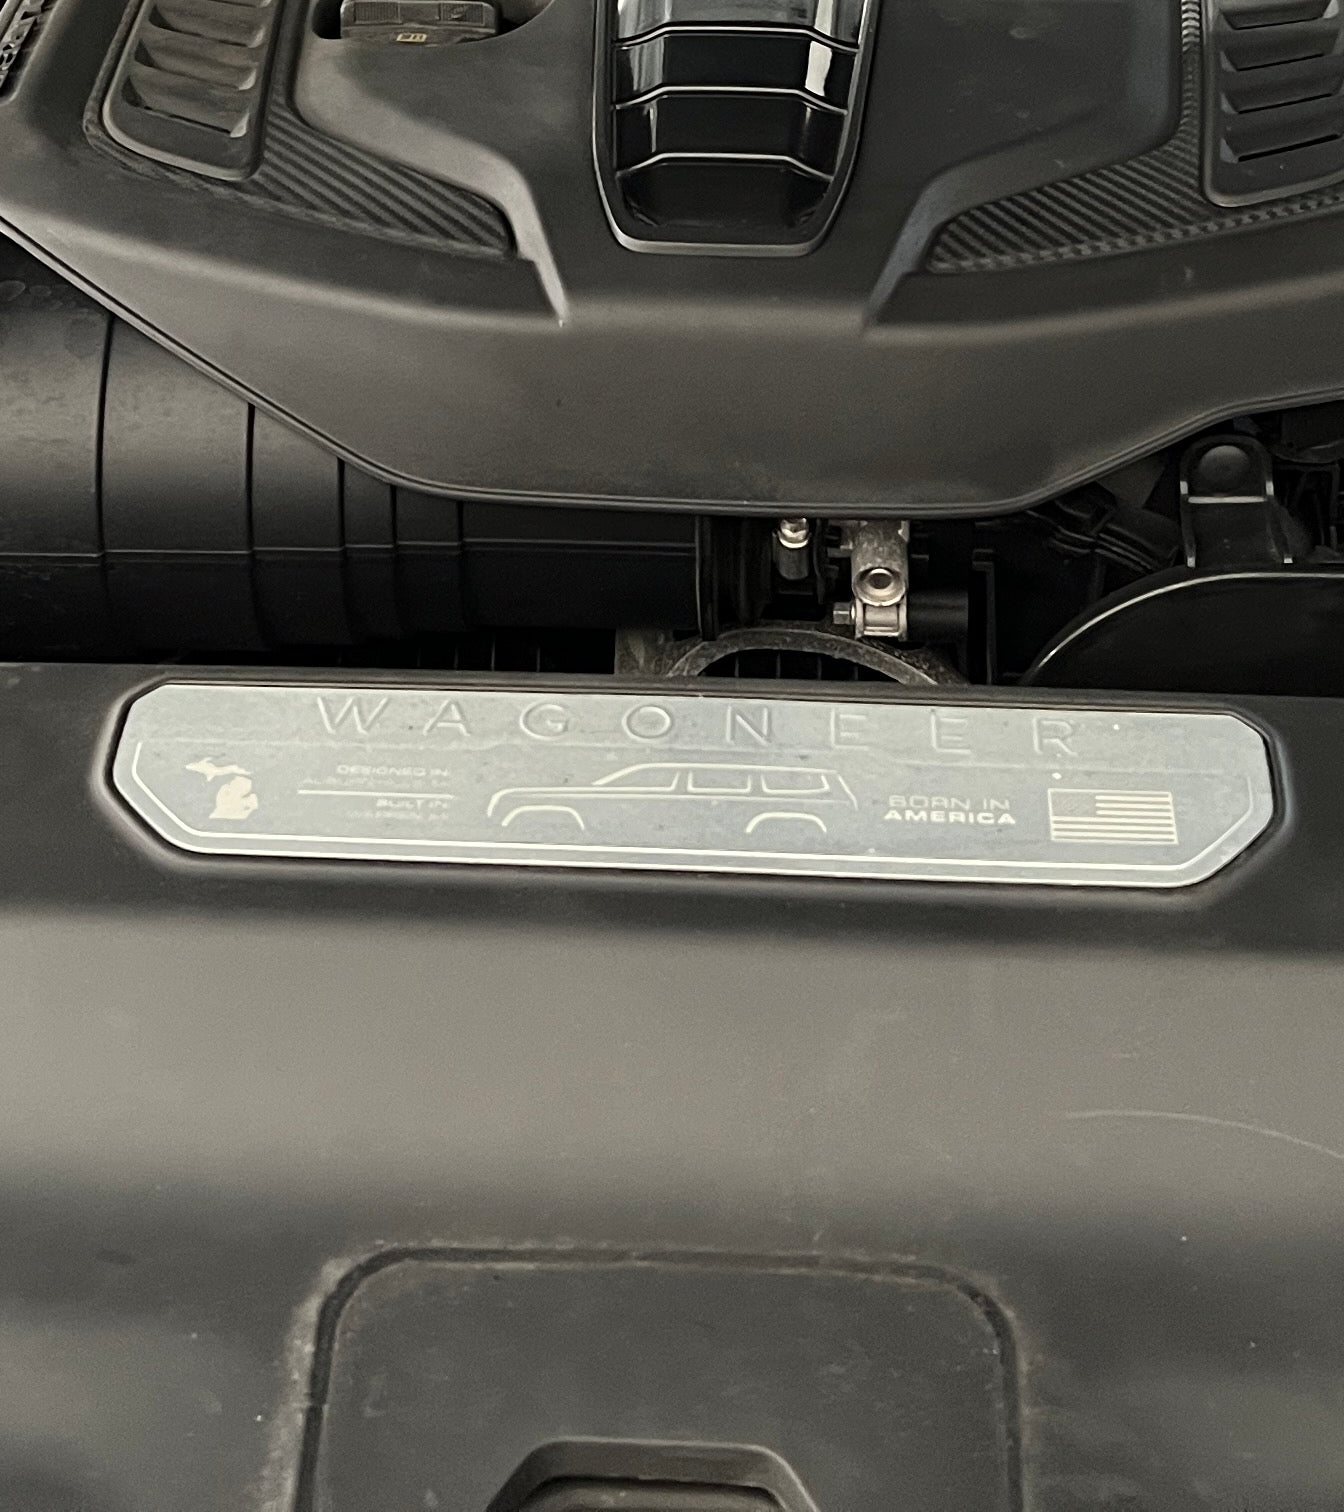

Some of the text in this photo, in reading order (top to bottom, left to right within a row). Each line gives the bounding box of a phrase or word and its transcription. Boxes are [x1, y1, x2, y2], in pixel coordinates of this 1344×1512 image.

[316, 695, 1078, 756] WAGONEER
[888, 794, 1011, 811] BORN IN
[883, 809, 1017, 825] AMERICA
